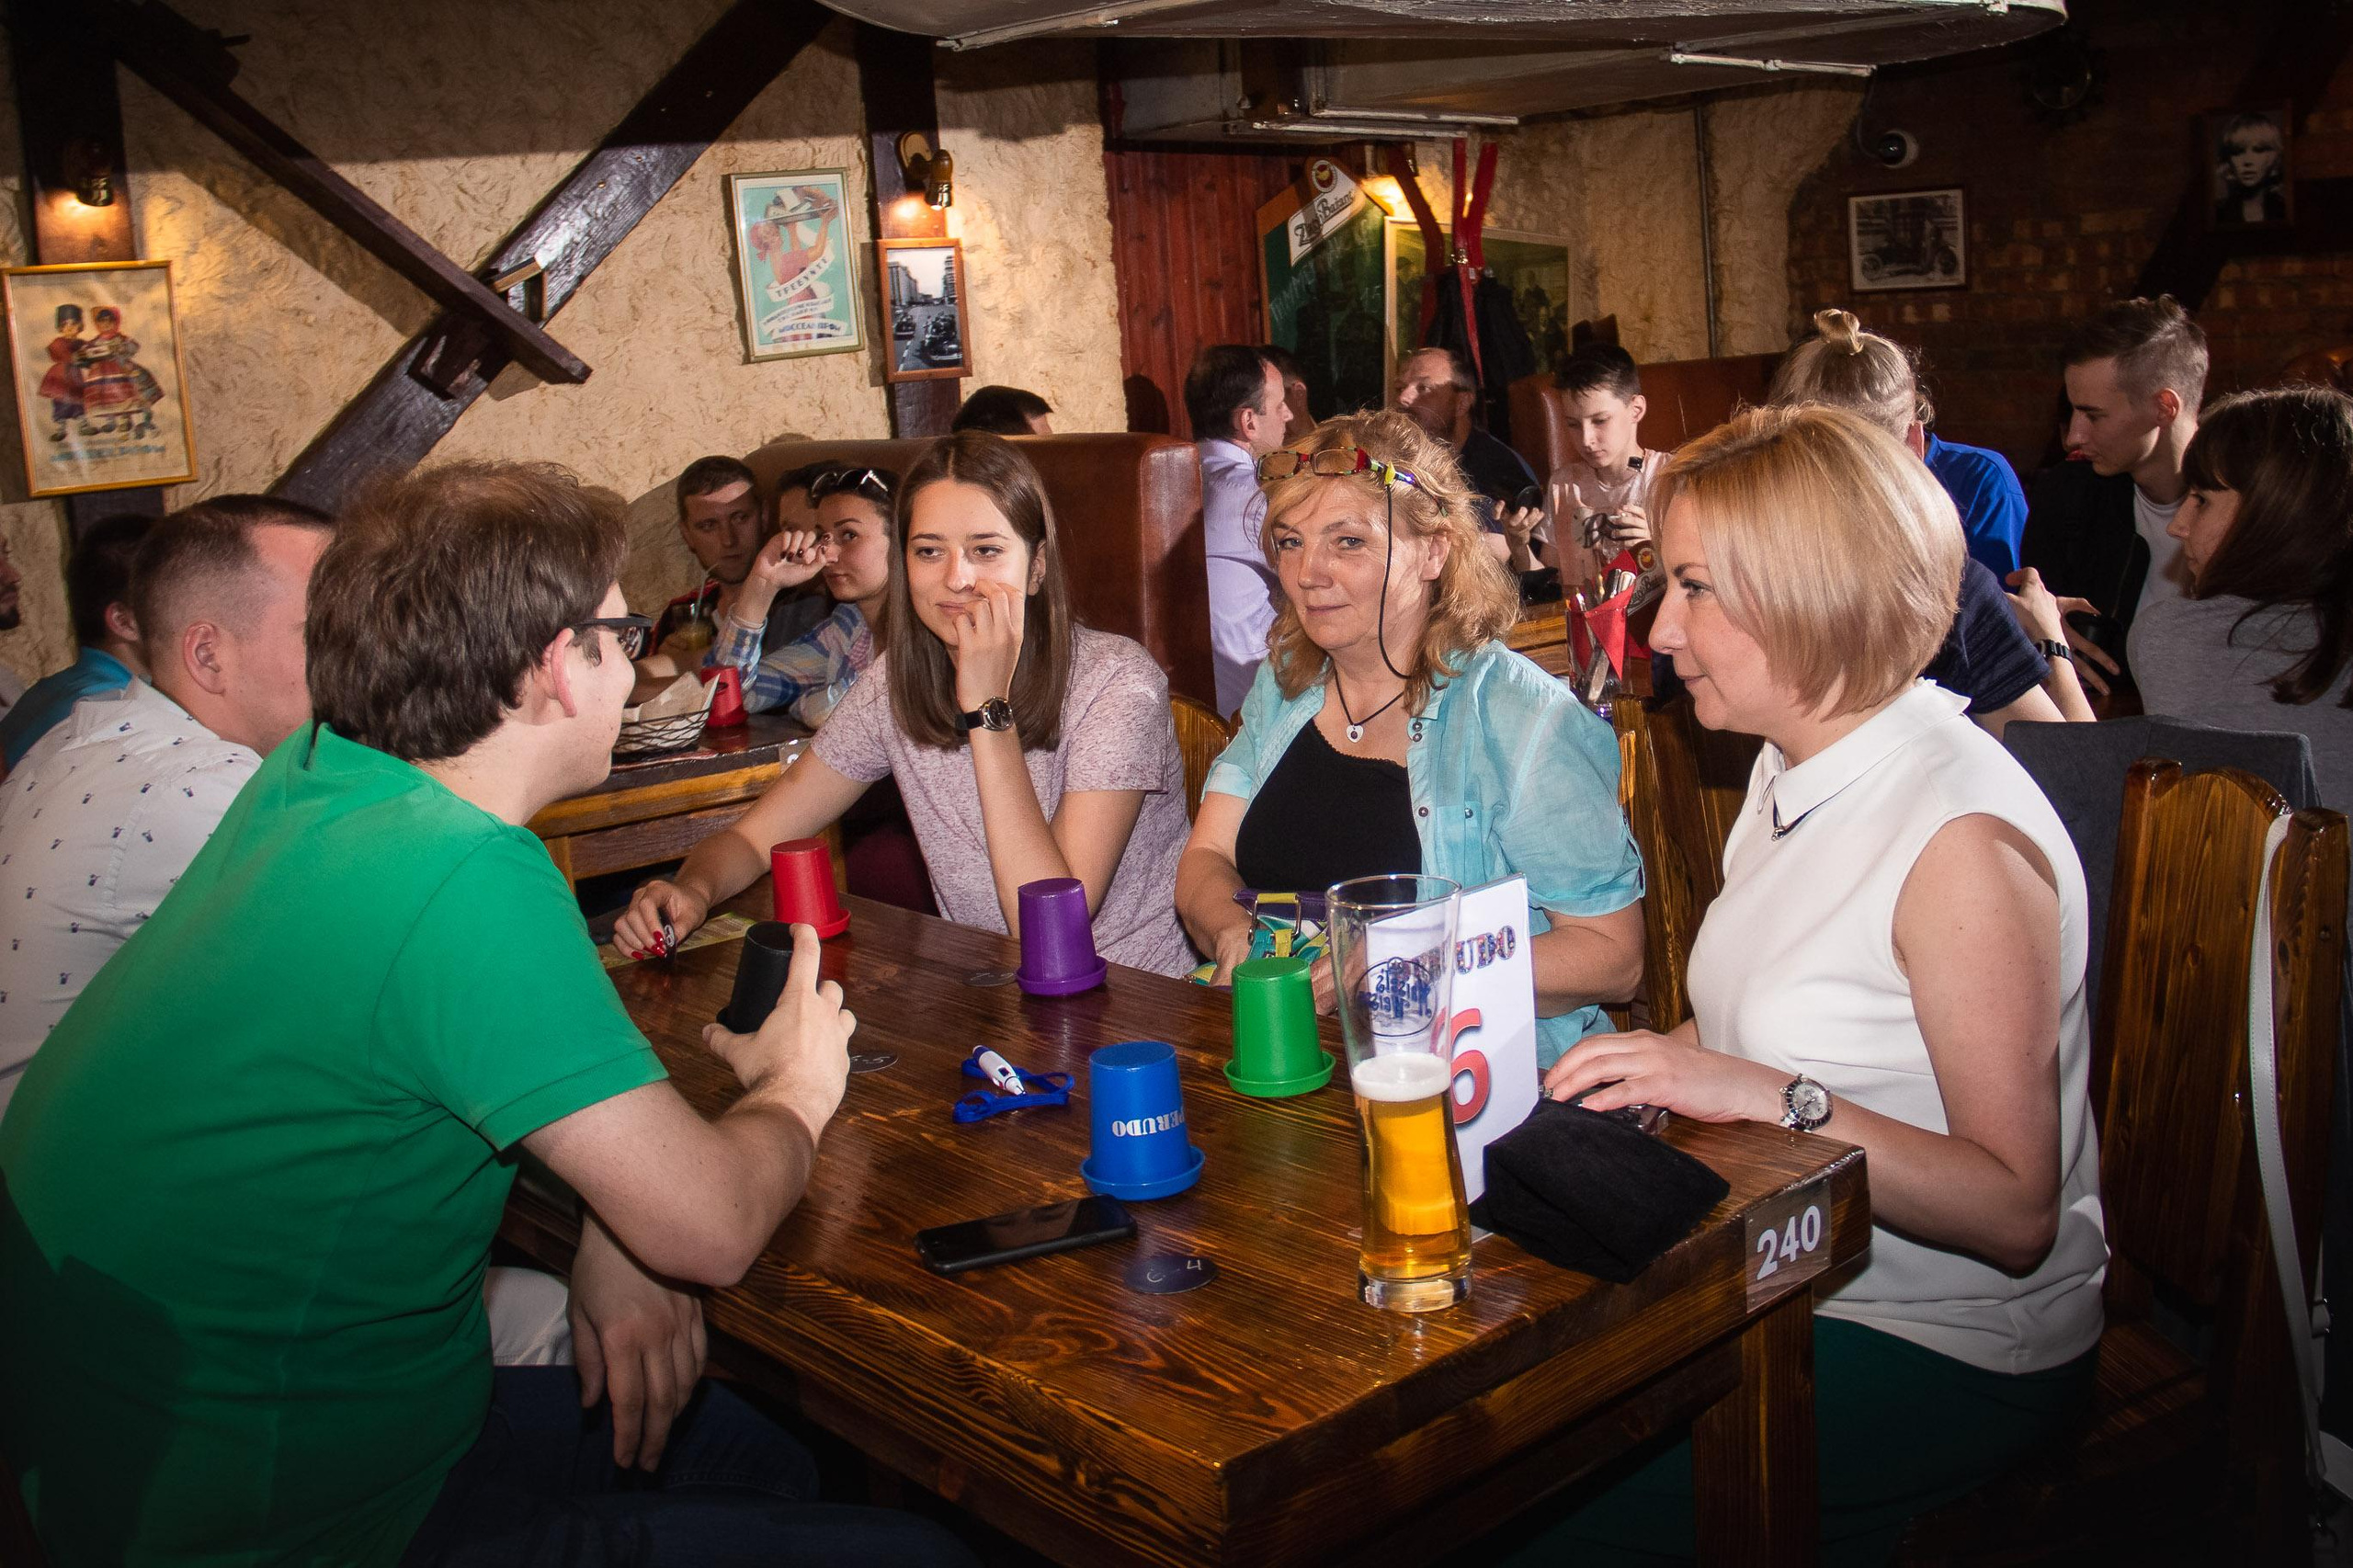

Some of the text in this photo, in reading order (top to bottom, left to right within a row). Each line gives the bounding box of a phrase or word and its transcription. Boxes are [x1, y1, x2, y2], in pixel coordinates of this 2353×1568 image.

[1433, 1007, 1490, 1125] 6
[1111, 1105, 1185, 1138] PERUDO
[1756, 1205, 1821, 1280] 240
